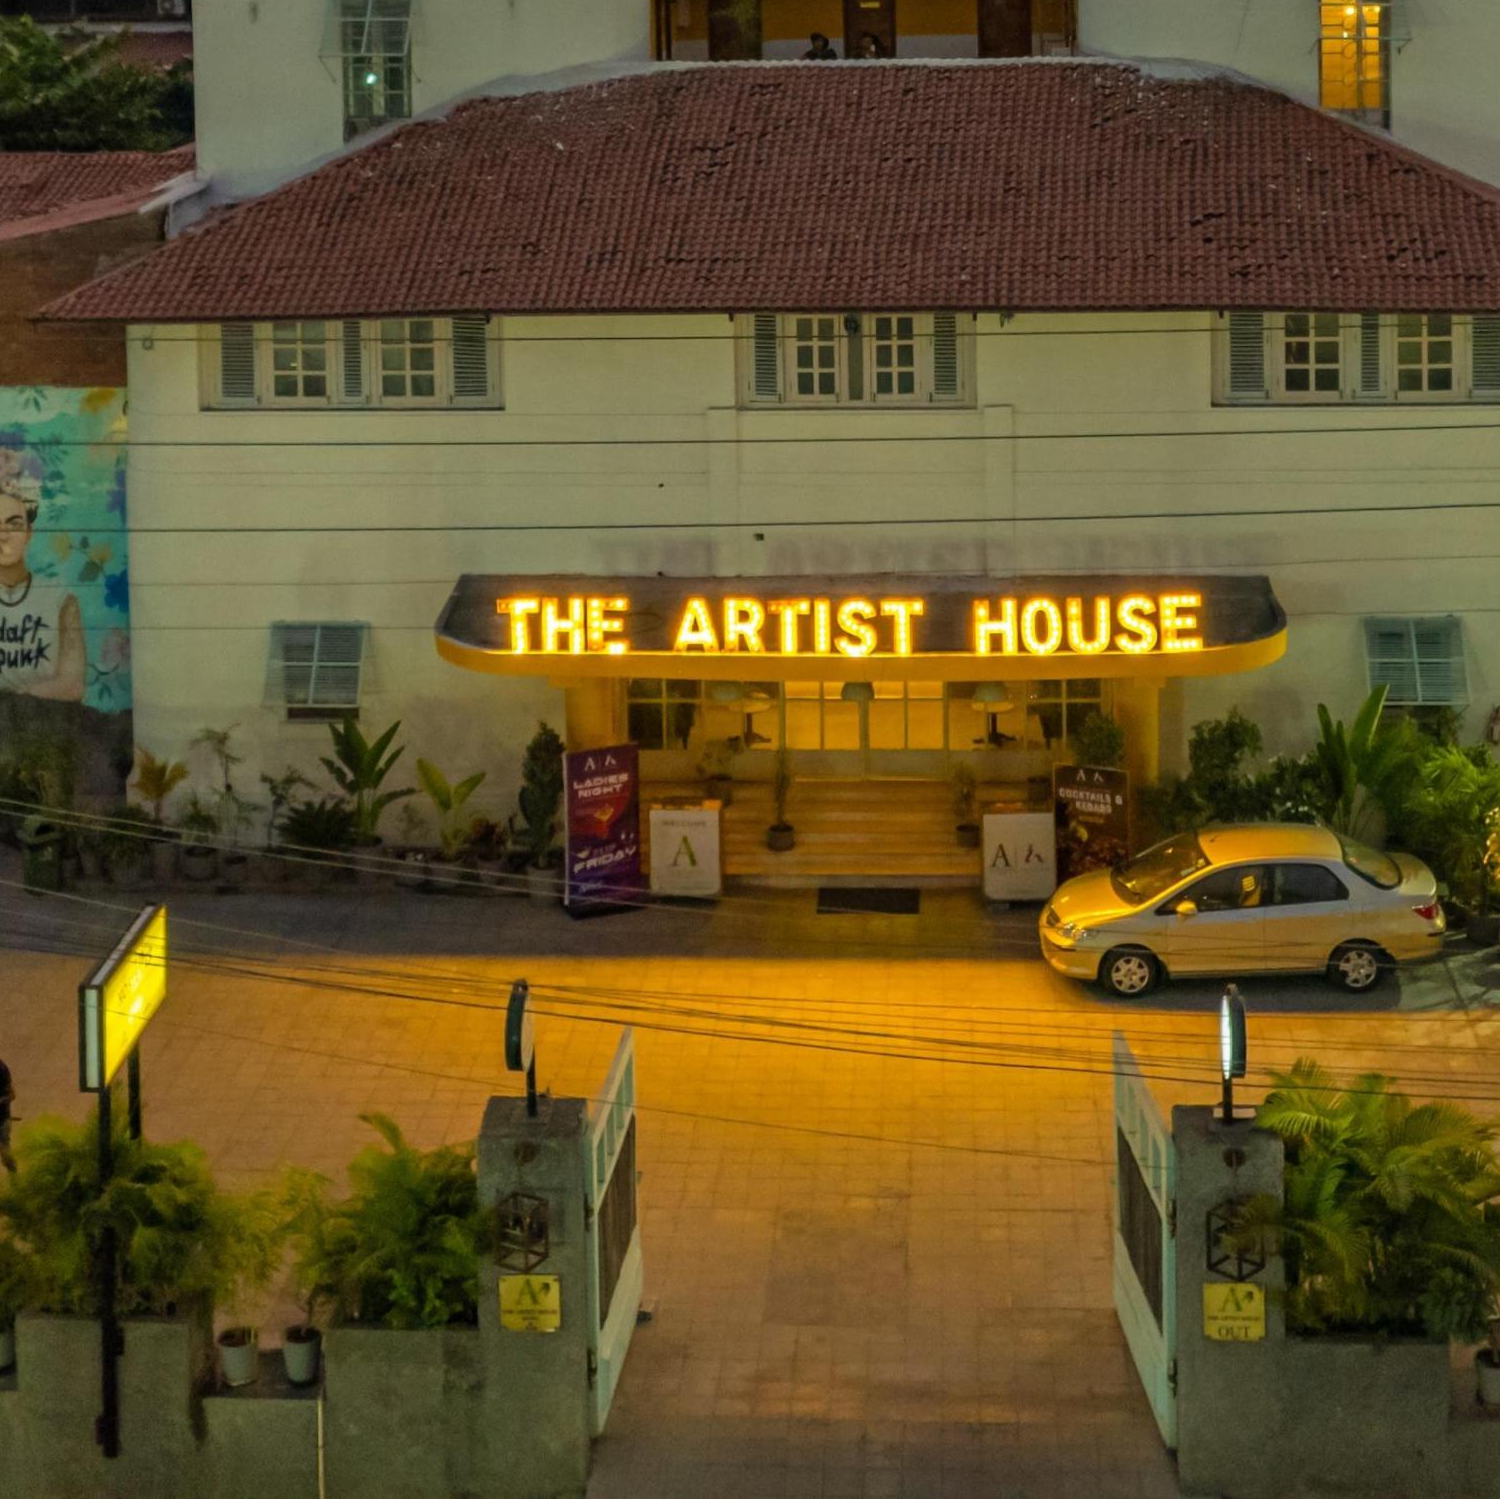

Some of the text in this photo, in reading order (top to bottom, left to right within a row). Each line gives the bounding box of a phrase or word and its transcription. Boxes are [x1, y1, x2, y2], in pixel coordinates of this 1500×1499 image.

[496, 594, 1205, 657] THE ARTIST HOUSE
[573, 772, 629, 790] LADIES
[578, 783, 624, 798] NIGHT
[1059, 787, 1112, 804] COCKTAILS
[573, 845, 637, 874] FRIDAY
[991, 843, 1011, 868] A
